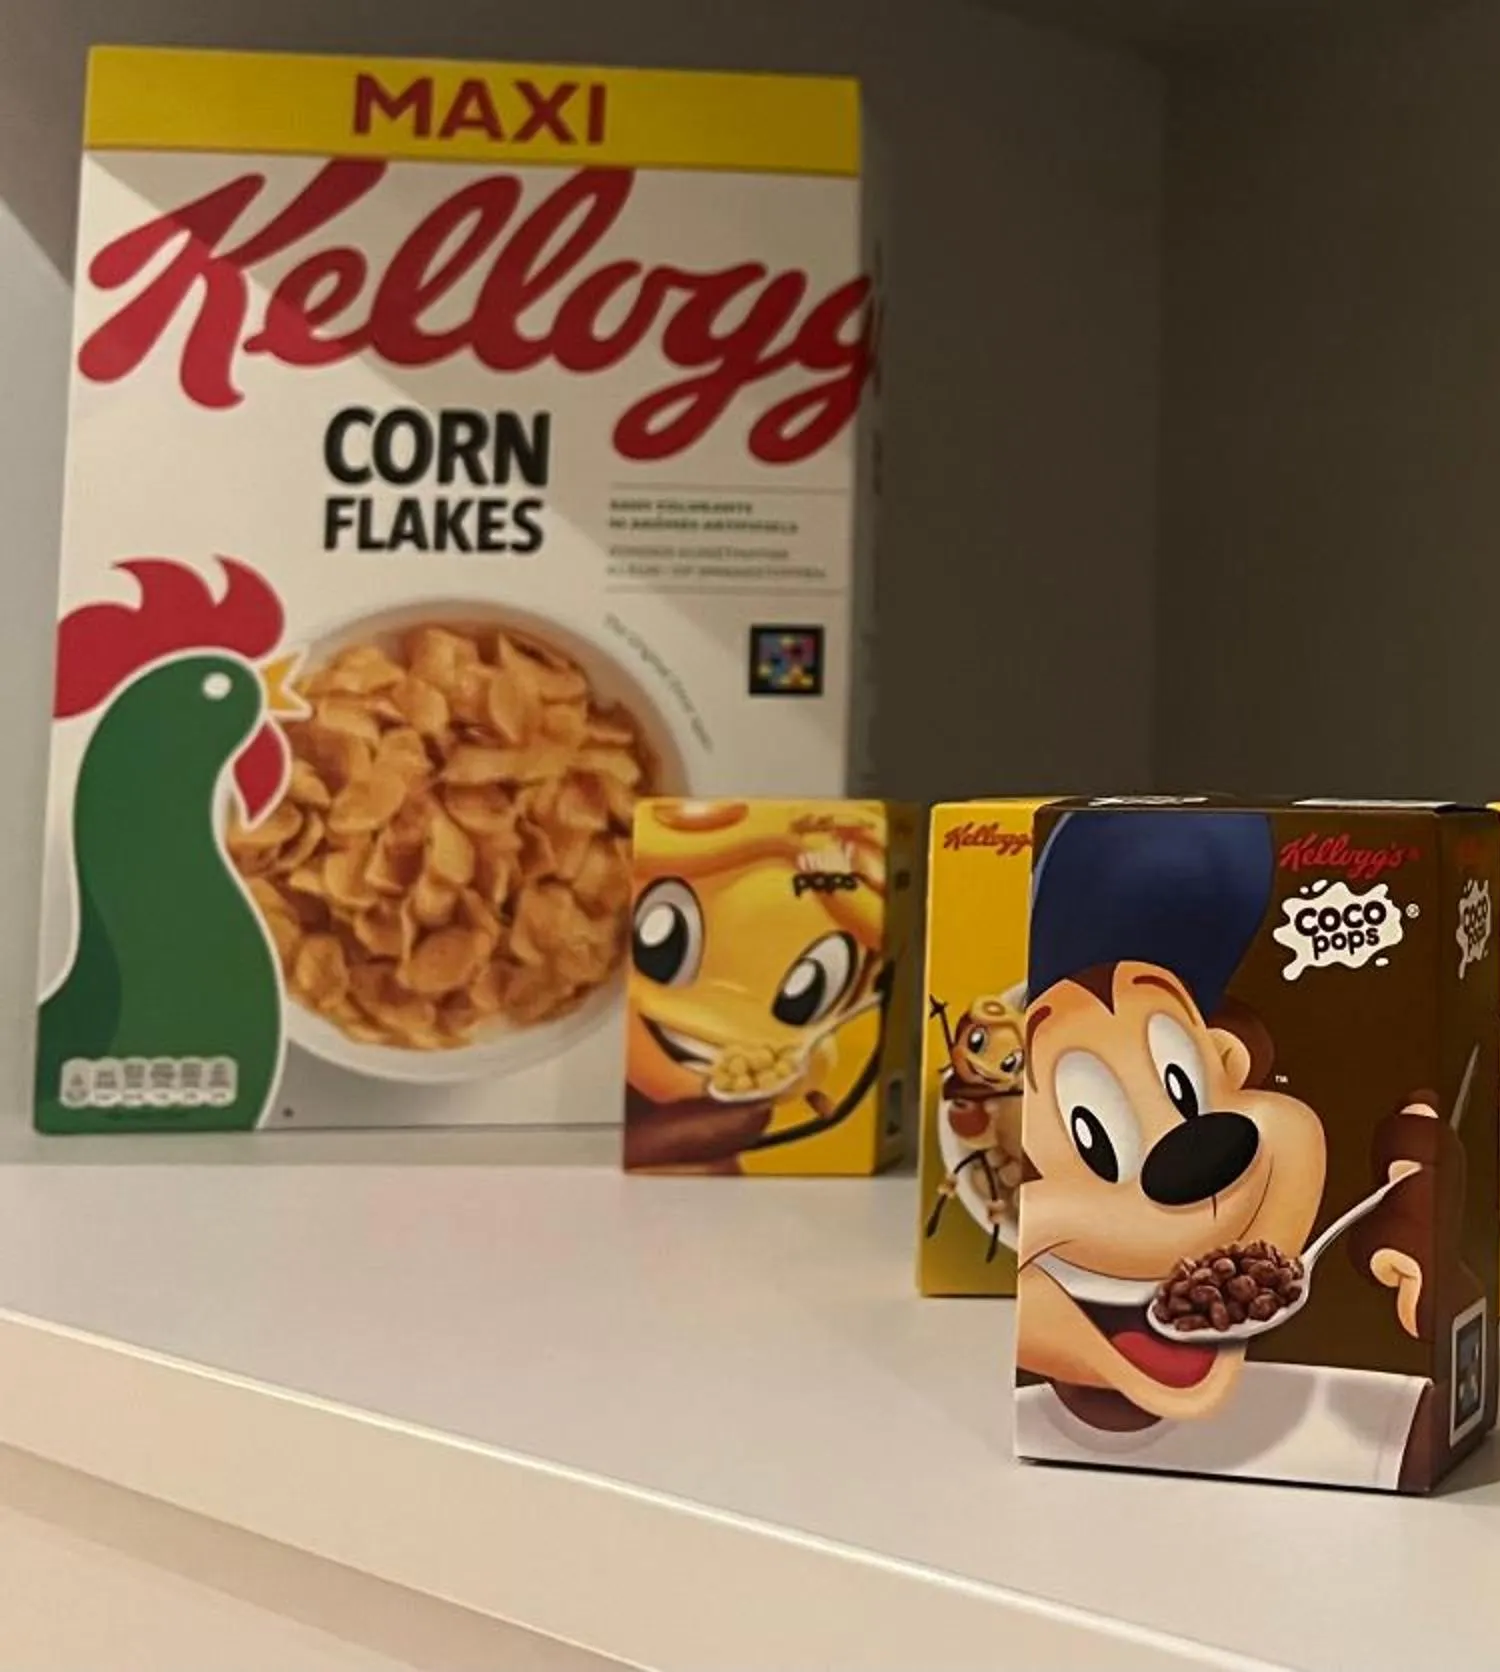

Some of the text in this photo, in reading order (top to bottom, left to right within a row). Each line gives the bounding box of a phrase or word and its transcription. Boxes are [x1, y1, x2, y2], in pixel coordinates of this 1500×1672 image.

[353, 74, 606, 144] MAXI
[324, 406, 551, 487] CORN
[324, 496, 544, 554] FLAKES
[1279, 832, 1404, 880] Kellogg's
[792, 871, 858, 897] pops
[1312, 928, 1380, 960] pops
